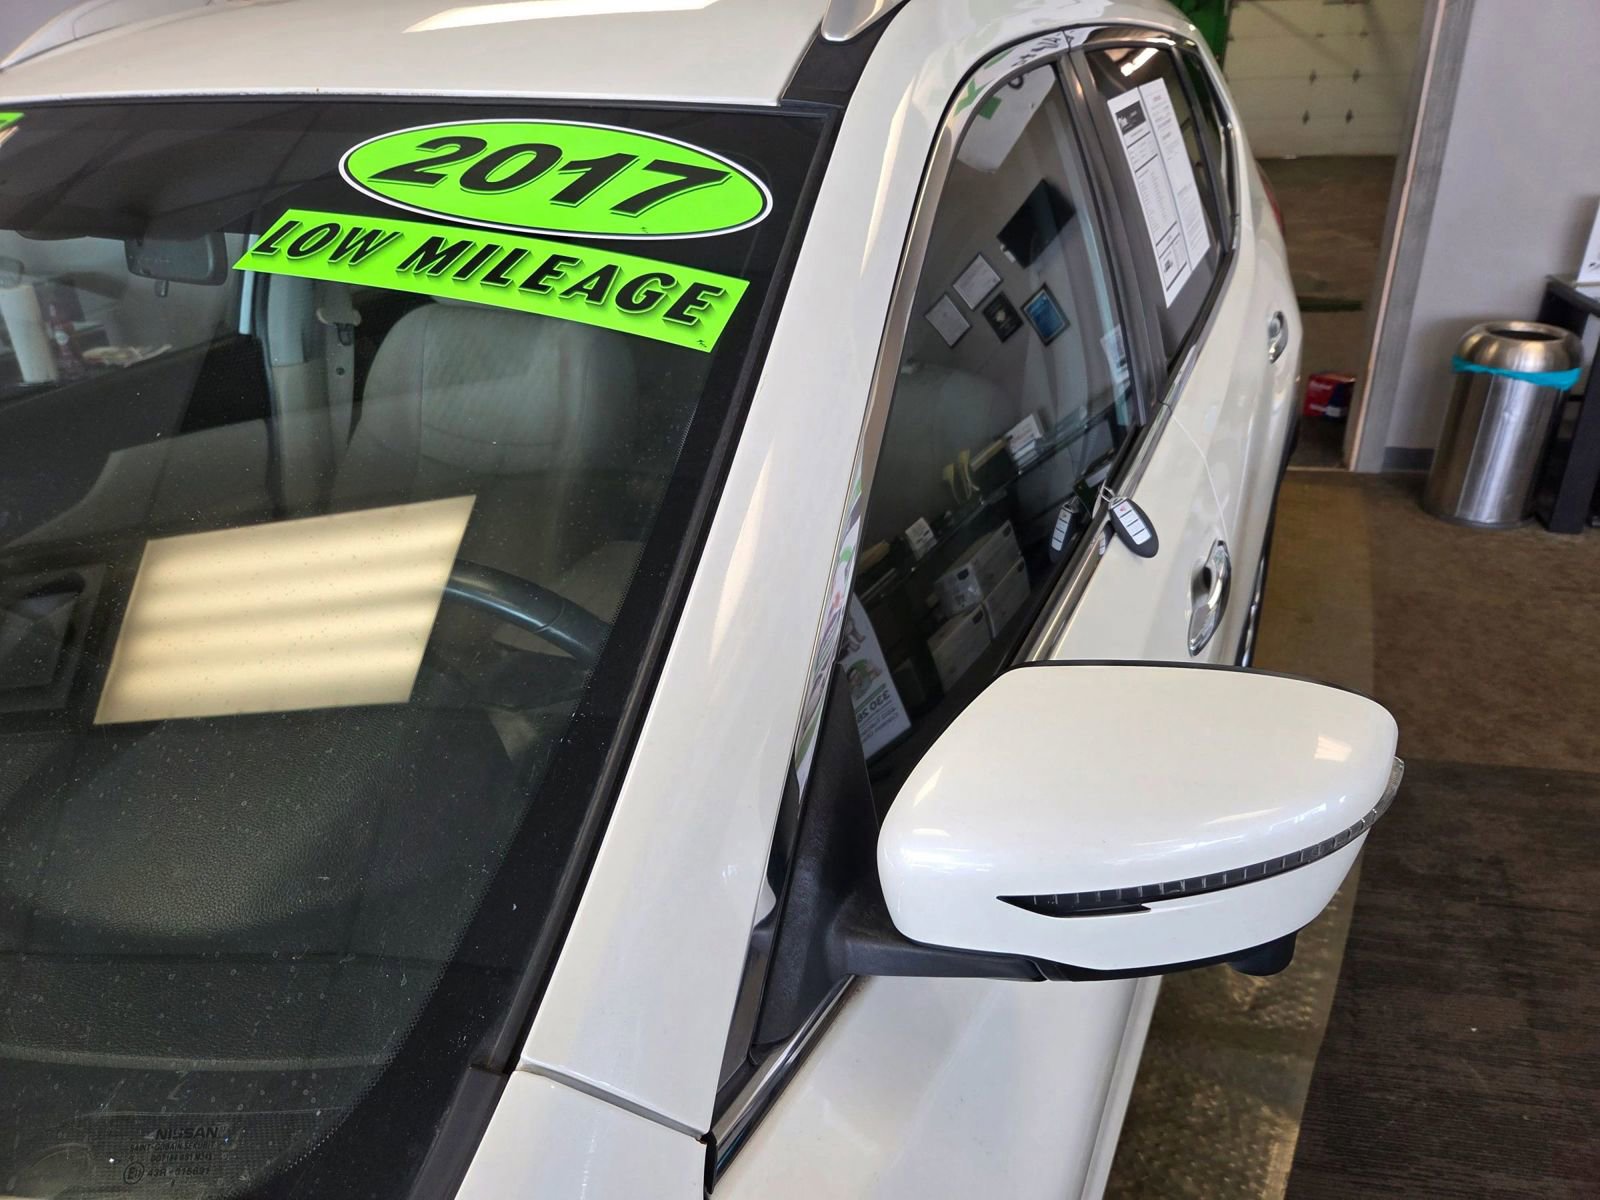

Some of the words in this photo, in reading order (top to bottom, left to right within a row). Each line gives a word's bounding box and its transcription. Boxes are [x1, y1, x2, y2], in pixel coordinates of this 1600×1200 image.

[367, 136, 732, 217] 2017
[251, 219, 402, 266] LOW
[396, 236, 726, 327] MILEAGE
[155, 1126, 219, 1140] NISSAN
